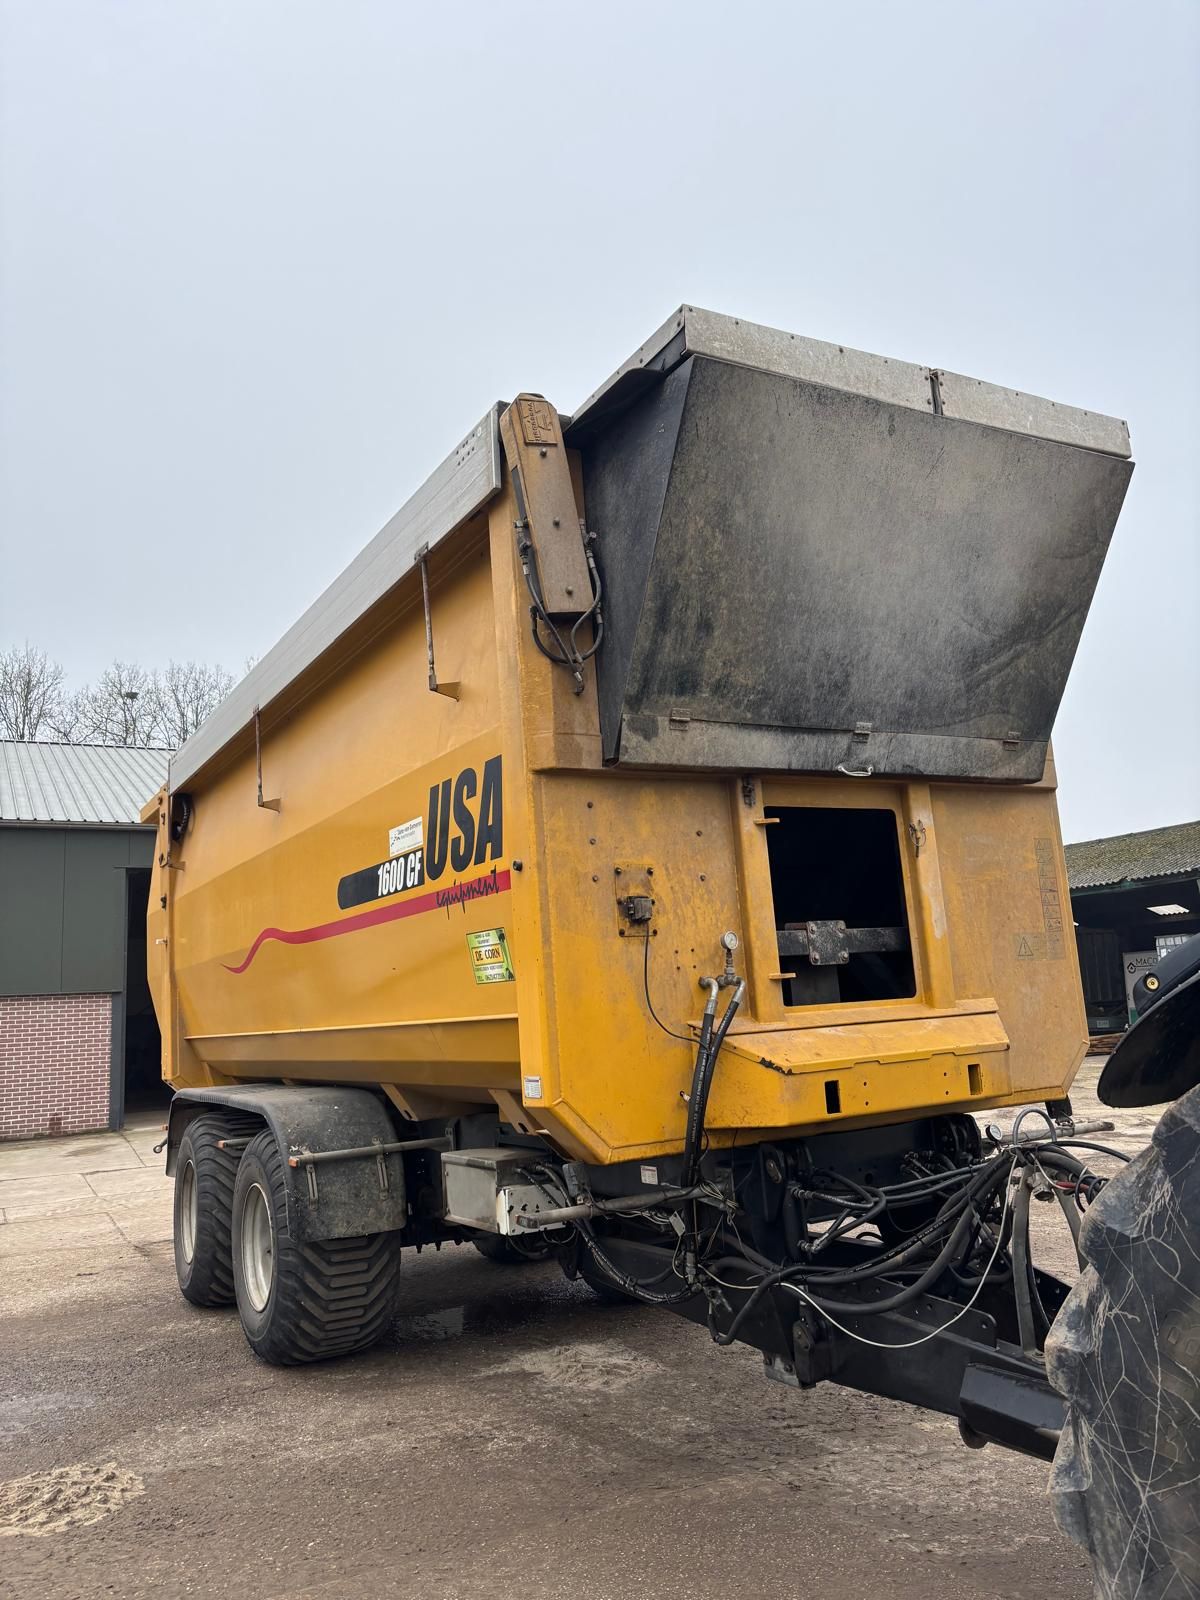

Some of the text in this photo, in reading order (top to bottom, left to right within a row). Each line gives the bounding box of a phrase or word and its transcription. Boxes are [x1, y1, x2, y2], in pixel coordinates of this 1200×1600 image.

[426, 754, 503, 881] USA
[378, 850, 422, 897] 1600 CF
[436, 864, 500, 920] equipment
[475, 947, 501, 962] DE CORN
